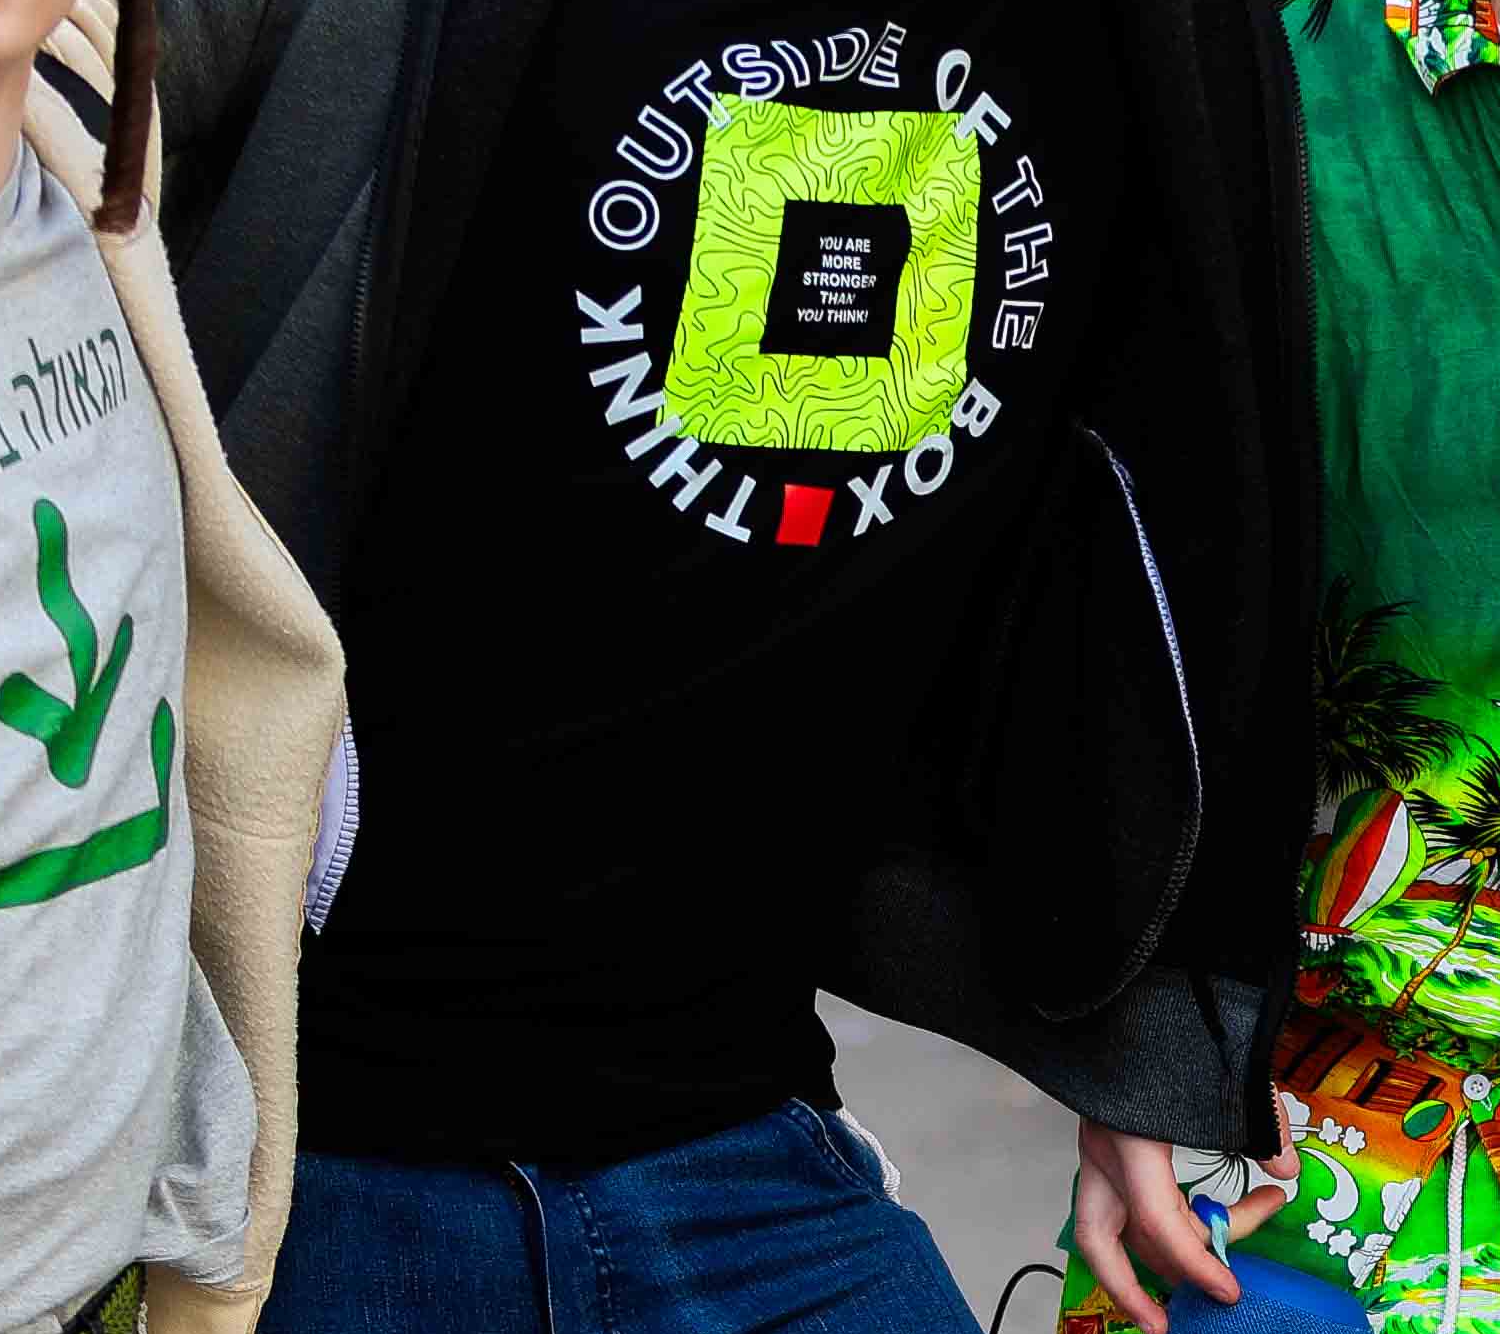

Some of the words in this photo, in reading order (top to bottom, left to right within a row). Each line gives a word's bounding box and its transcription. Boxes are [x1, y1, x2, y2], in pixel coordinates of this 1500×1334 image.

[588, 21, 907, 251] OUTSIDE
[936, 48, 1012, 147] OF
[803, 271, 877, 289] STRONGER
[819, 236, 843, 251] YOU
[845, 237, 871, 253] ARE
[822, 254, 862, 271] MORE
[991, 155, 1053, 350] THE
[797, 307, 824, 322] YOU
[827, 308, 869, 323] THINK!
[820, 290, 856, 305] THAN
[11, 327, 128, 452] הגאולה
[575, 284, 757, 543] THINK
[847, 378, 1001, 537] BOX
